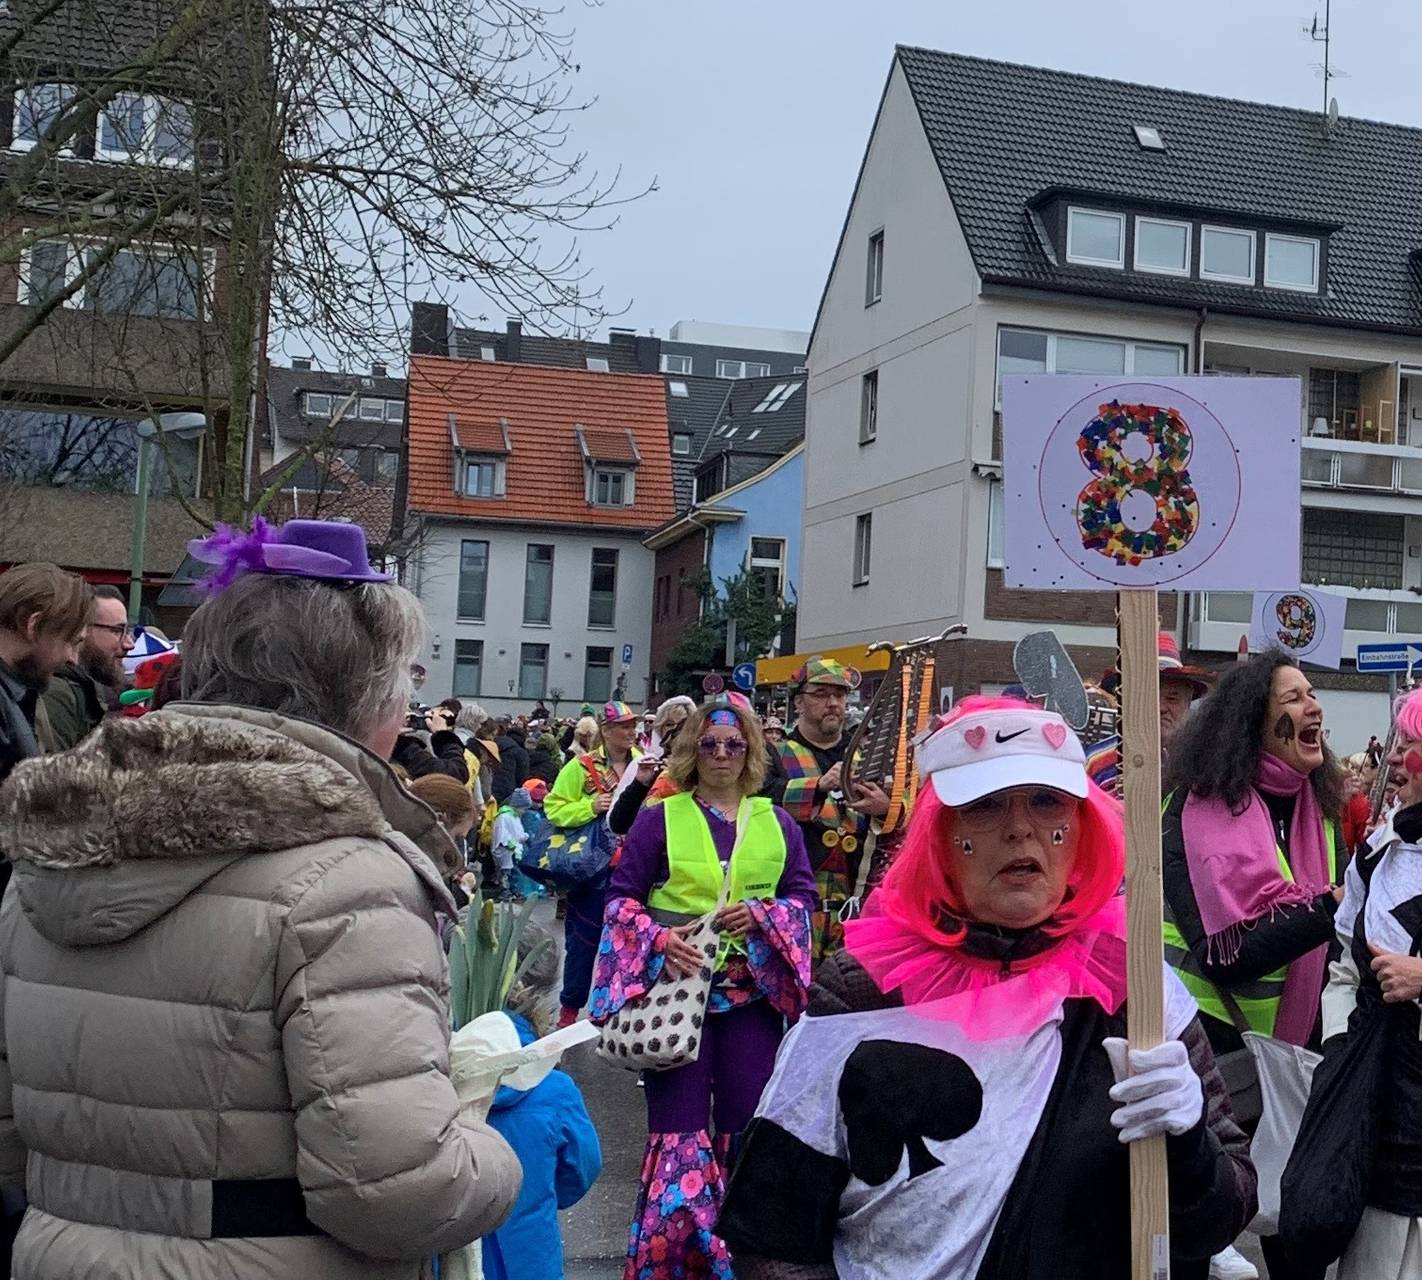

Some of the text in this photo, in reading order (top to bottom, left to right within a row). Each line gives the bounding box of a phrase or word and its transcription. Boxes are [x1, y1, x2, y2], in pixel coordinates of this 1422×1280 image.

[1077, 402, 1200, 563] 8
[1276, 594, 1316, 649] 9
[1361, 653, 1409, 661] Einbahnstraße
